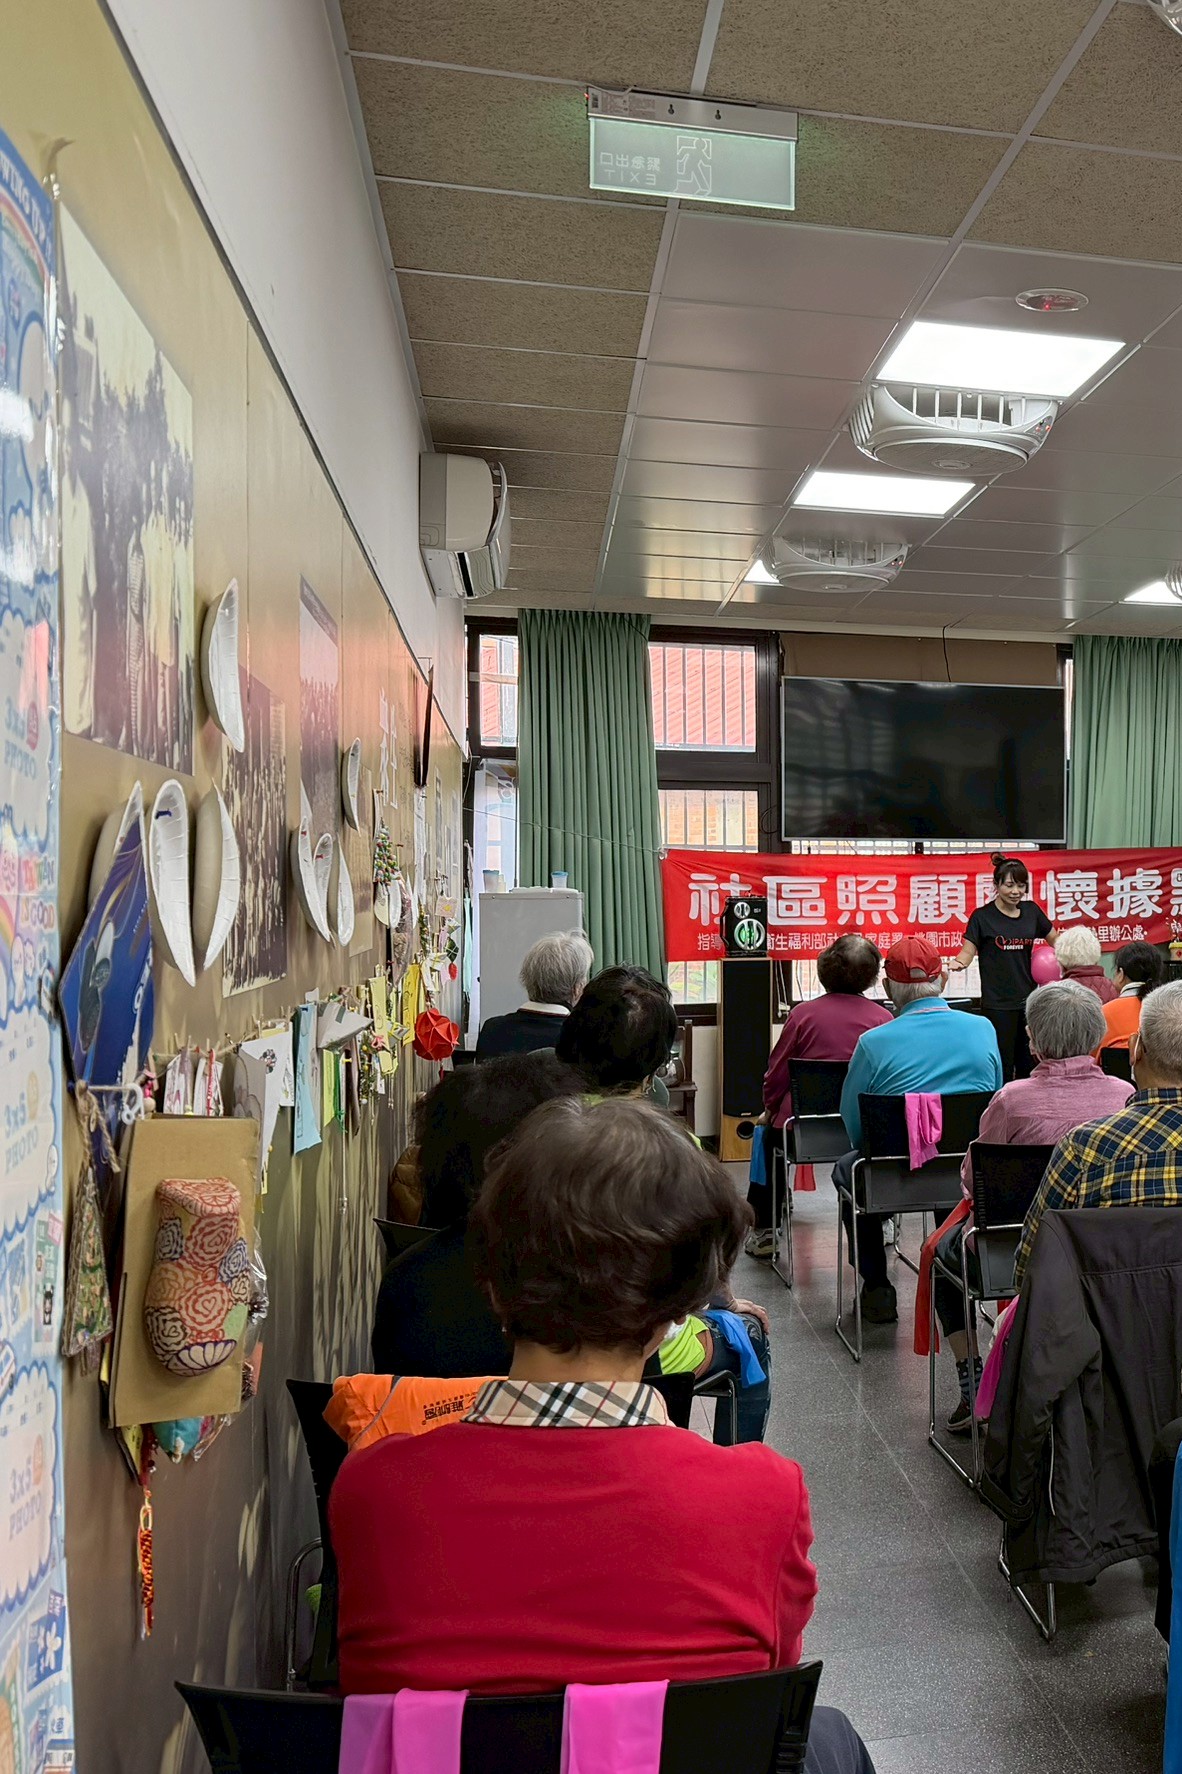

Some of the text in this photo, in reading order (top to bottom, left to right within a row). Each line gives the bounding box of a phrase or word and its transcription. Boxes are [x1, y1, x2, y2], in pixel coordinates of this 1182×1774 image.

[4, 740, 36, 780] PHOTO
[5, 1125, 39, 1176] PHOTO
[9, 1491, 42, 1541] PHOTO
